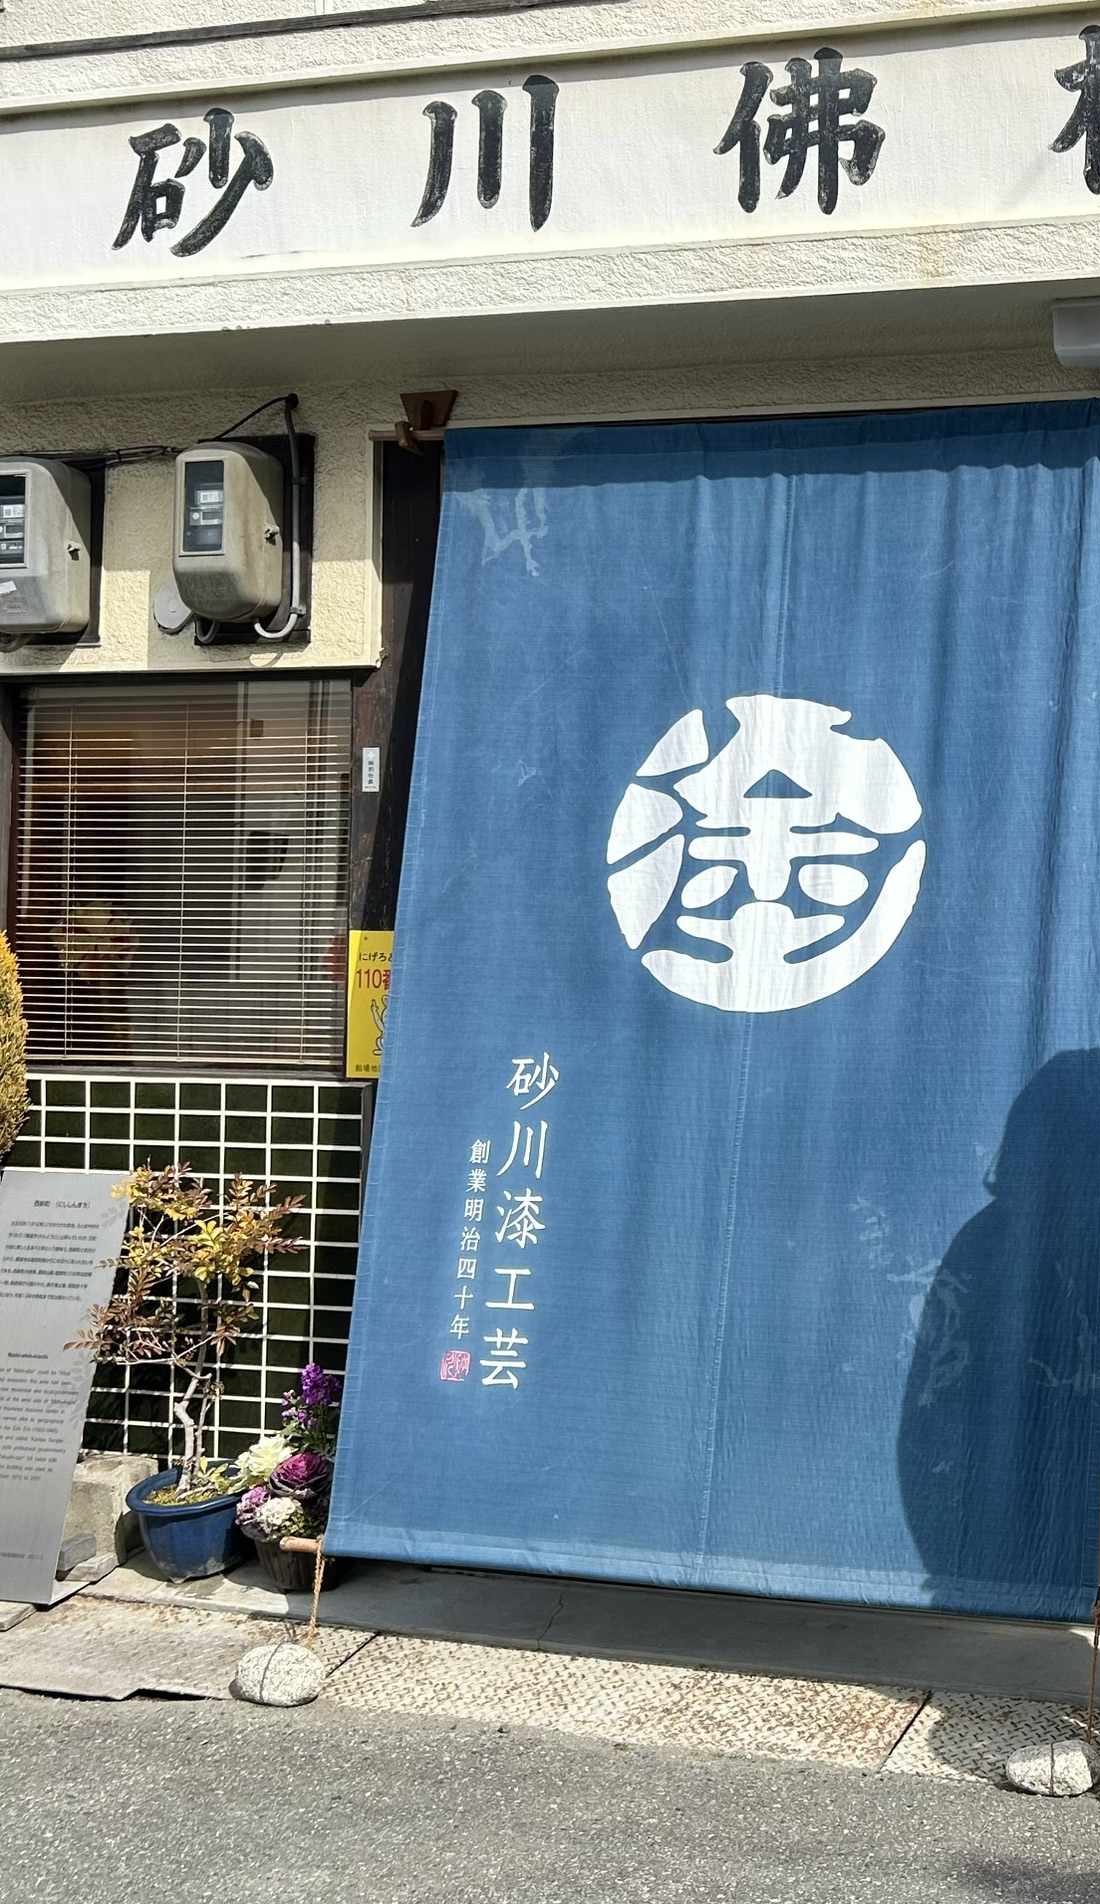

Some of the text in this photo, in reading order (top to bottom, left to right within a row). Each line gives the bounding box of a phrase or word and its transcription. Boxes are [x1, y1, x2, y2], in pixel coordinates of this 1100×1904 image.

[355, 1063, 381, 1073] 船場地
[450, 1138, 492, 1340] 創業明治四十年
[479, 1051, 560, 1390] 砂川漆工芸
